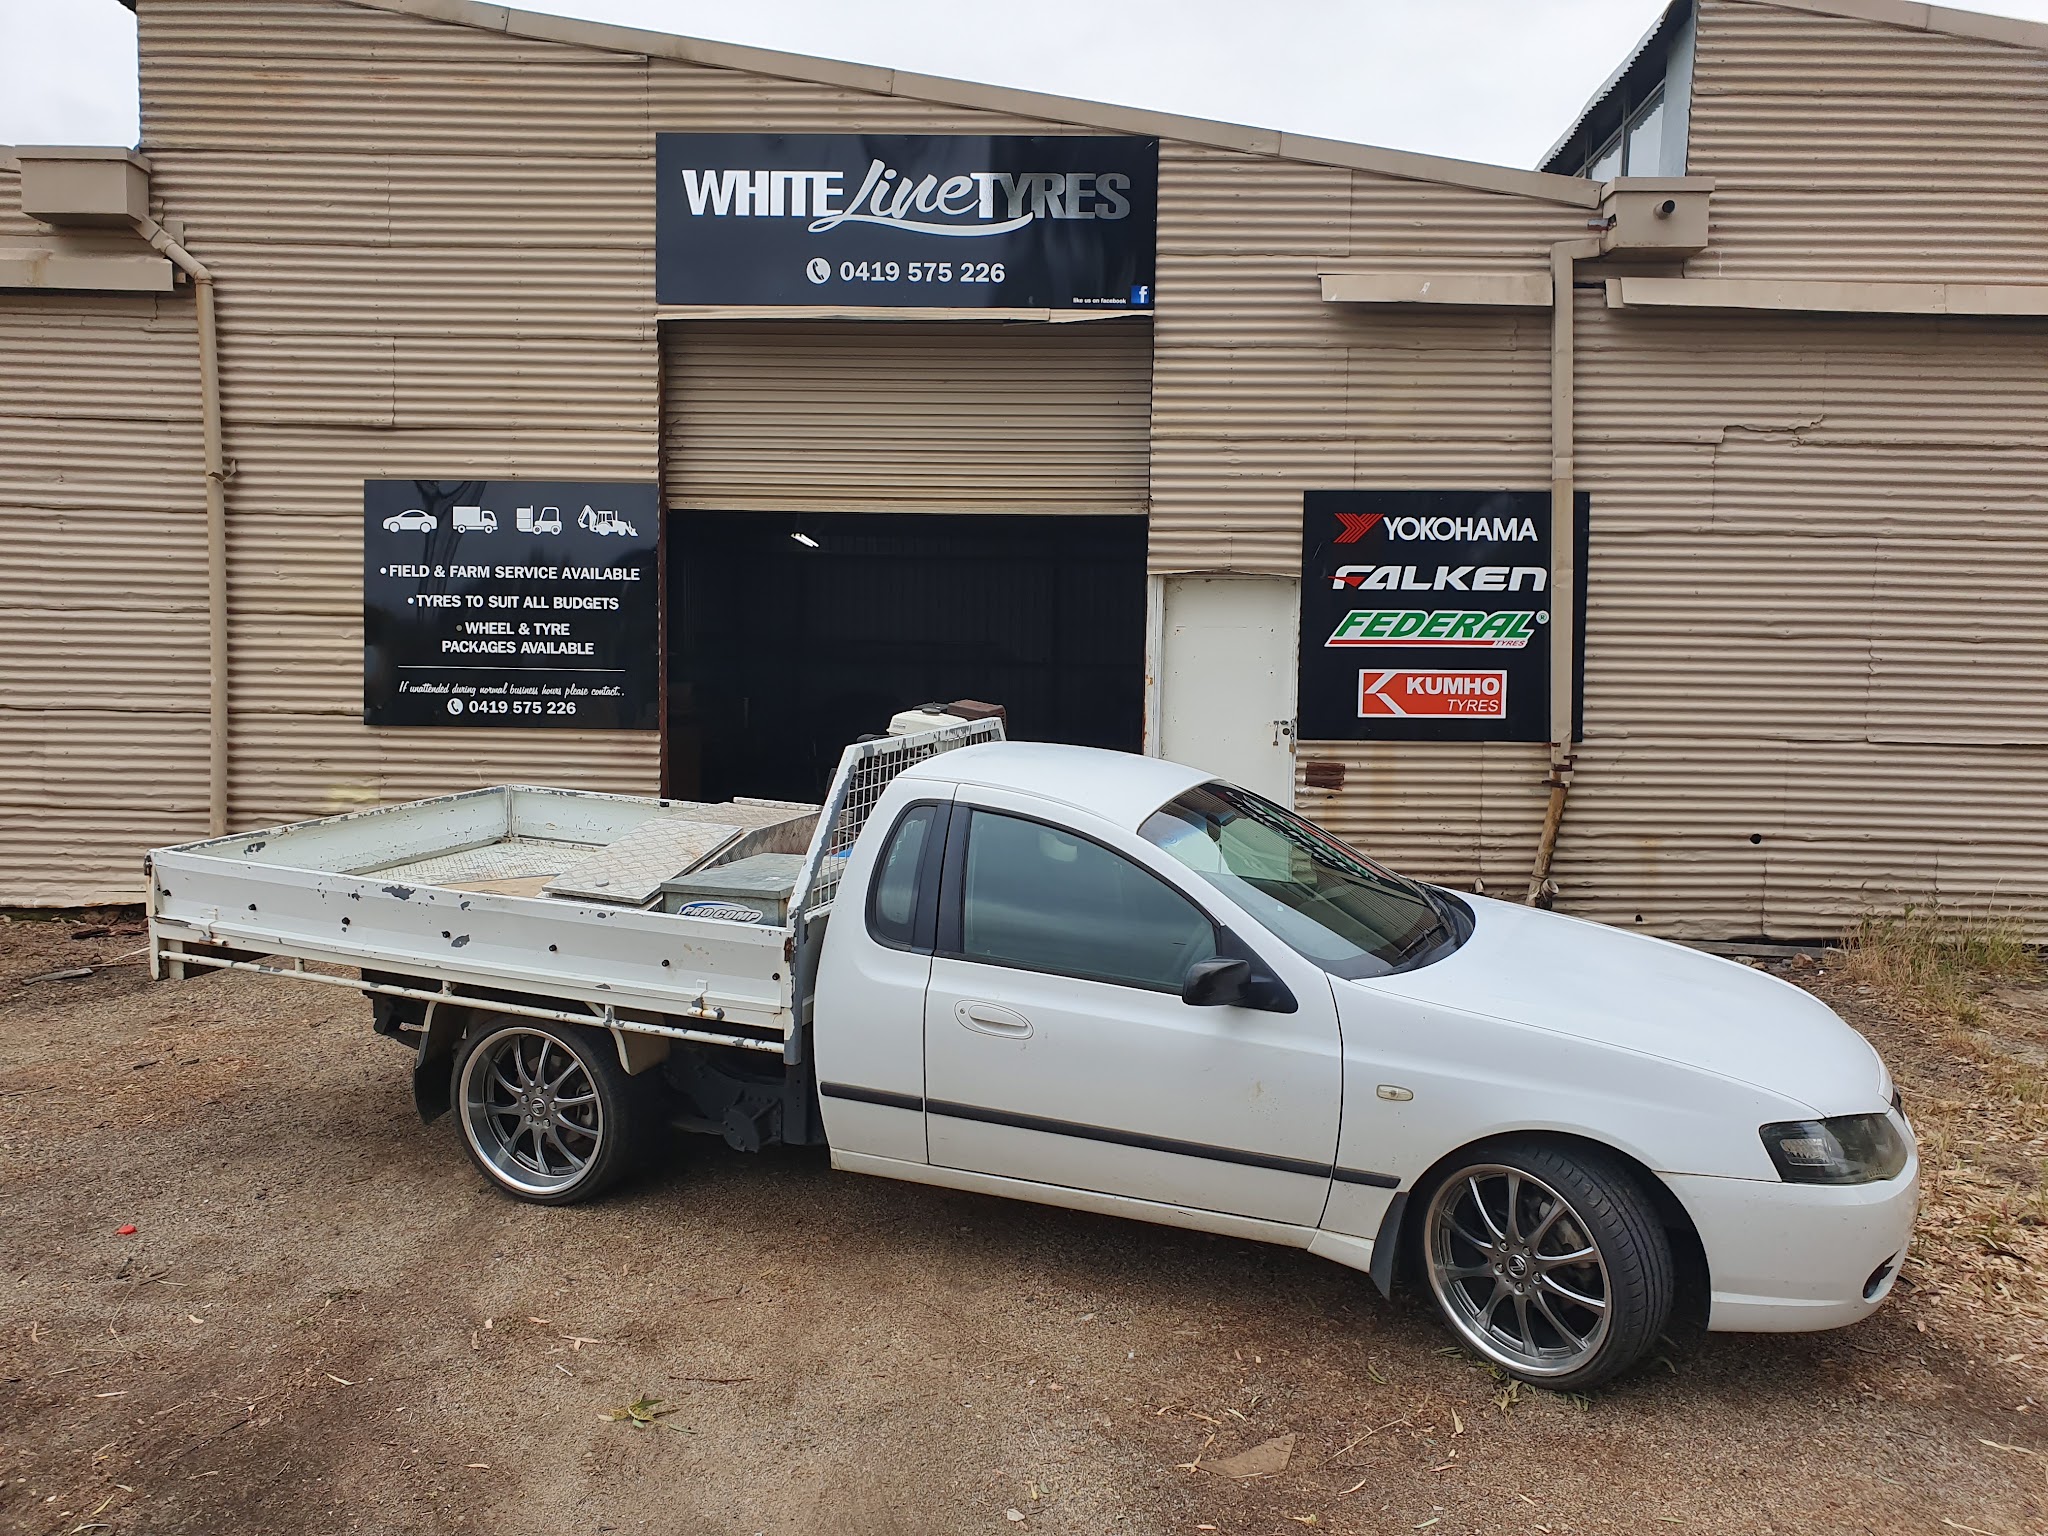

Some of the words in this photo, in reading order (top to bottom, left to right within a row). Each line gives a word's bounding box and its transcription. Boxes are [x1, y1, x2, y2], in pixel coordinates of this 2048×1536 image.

[682, 170, 844, 217] WHITE
[808, 159, 1034, 236] Line
[970, 171, 1131, 220] TYRES
[840, 261, 899, 282] 0419
[908, 262, 953, 283] 575
[960, 263, 1005, 283] 226
[1383, 517, 1538, 541] YOKOHAMA
[389, 564, 429, 578] FIELD
[434, 565, 445, 578] &
[450, 565, 490, 578] FARM
[495, 566, 557, 579] SERVICE
[561, 567, 640, 581] AVAILABLE
[1328, 565, 1547, 591] FALKEN
[416, 595, 461, 608] TYRES
[465, 595, 484, 608] TO
[488, 596, 519, 609] SUIT
[523, 596, 549, 609] ALL
[553, 597, 619, 610] BUDGETS
[465, 622, 514, 634] WHEEL
[518, 623, 530, 635] &
[534, 623, 570, 636] TYRE
[1335, 611, 1535, 639] FEDERAL
[442, 641, 516, 654] PACKAGES
[520, 642, 594, 655] AVAILABLE
[399, 681, 409, 692] If
[410, 683, 450, 693] unattended
[452, 683, 476, 697] during
[480, 682, 507, 694] normal
[510, 684, 538, 695] business
[542, 684, 561, 695] hours
[564, 683, 588, 698] please
[1406, 677, 1500, 695] KUMHO
[469, 701, 508, 713] 0419
[513, 702, 542, 714] 575
[547, 702, 576, 714] 226
[1447, 699, 1499, 711] TYRES
[681, 906, 714, 917] PRO
[713, 909, 761, 922] COMP
